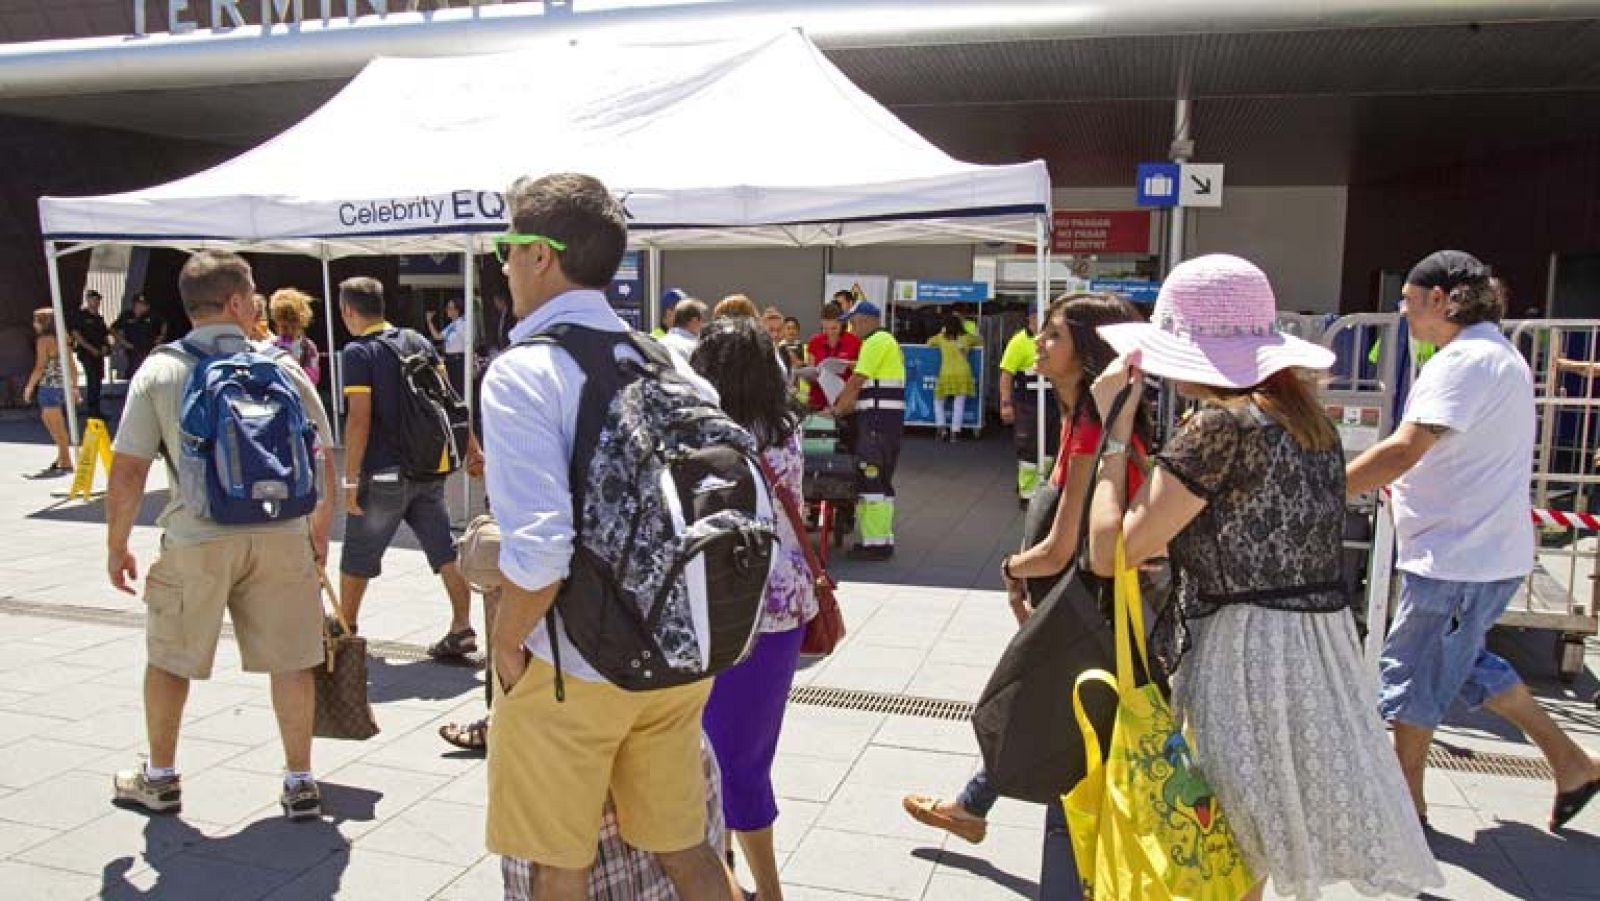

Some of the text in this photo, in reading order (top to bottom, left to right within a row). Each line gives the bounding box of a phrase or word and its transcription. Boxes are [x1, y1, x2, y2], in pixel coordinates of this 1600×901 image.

[133, 0, 500, 35] TERMI
[338, 196, 445, 226] Celebrity
[1056, 241, 1106, 250] NO ENTRY
